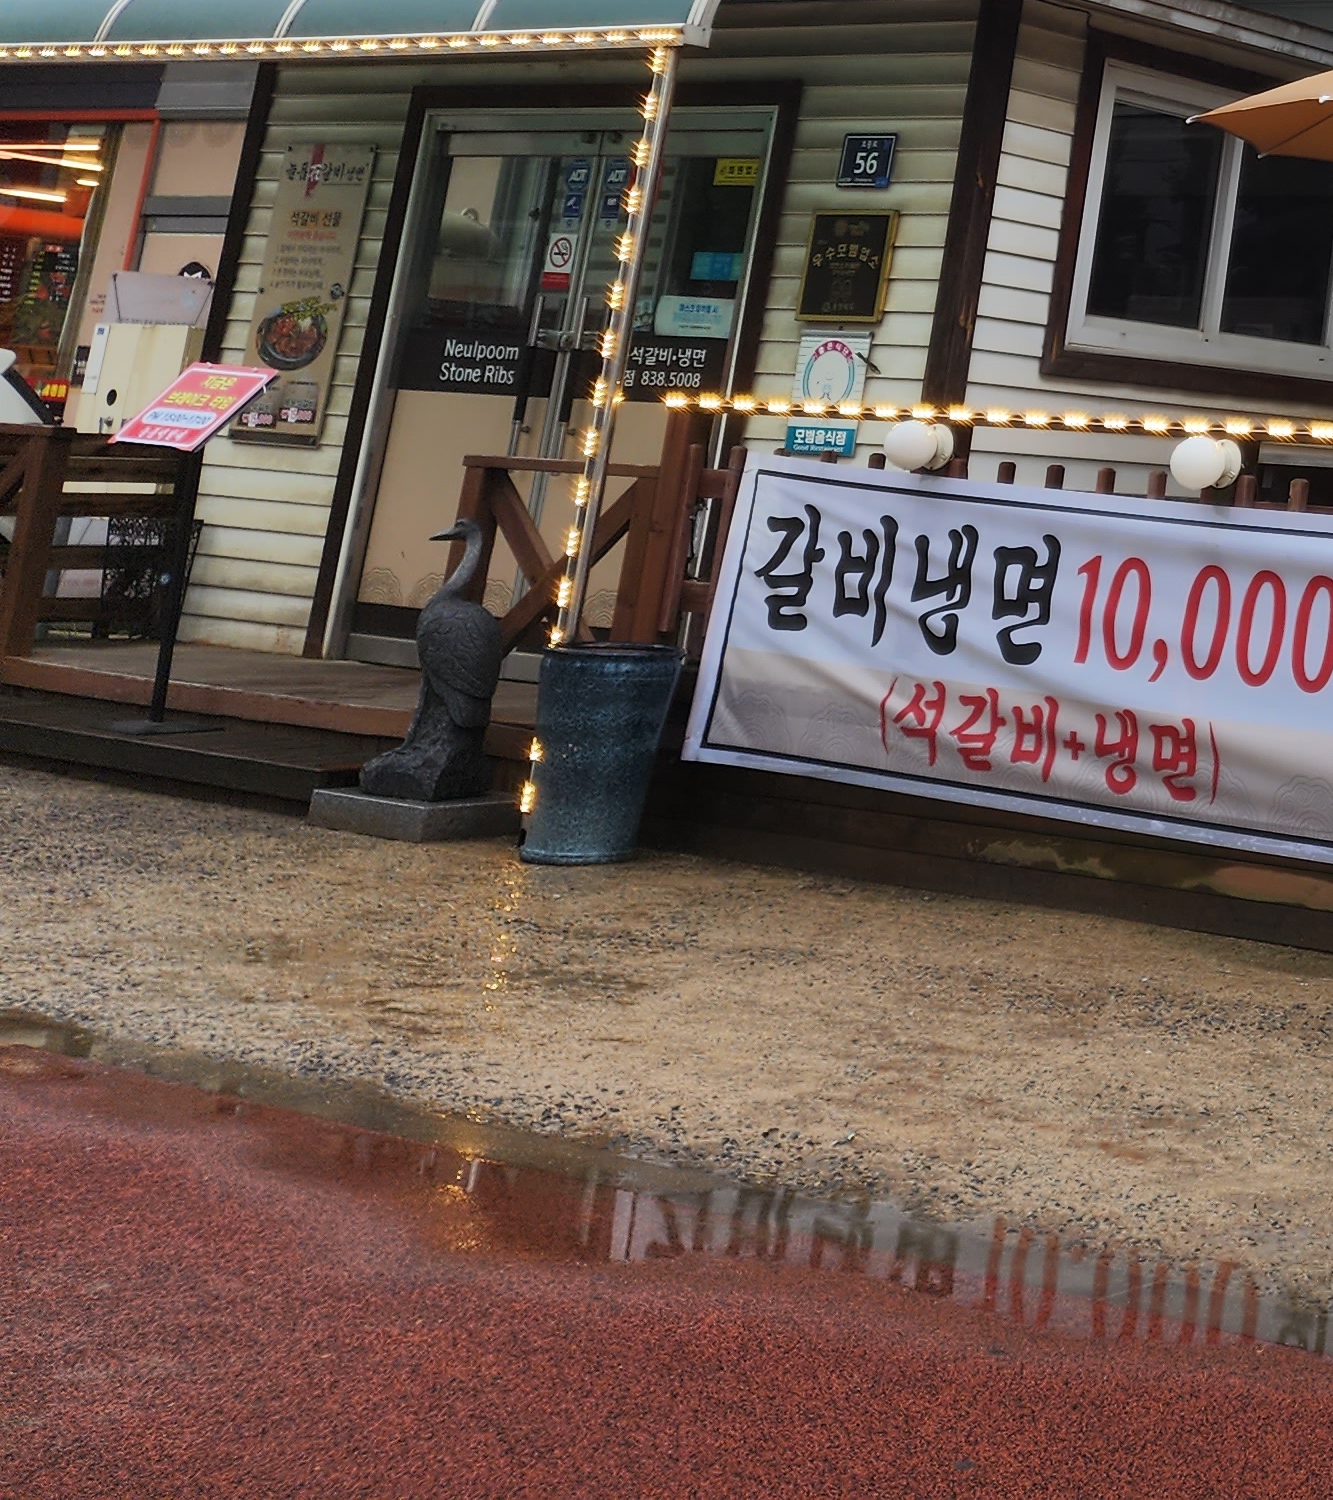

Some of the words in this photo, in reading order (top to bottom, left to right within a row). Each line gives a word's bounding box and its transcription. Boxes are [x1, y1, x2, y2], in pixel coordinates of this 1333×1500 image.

[853, 152, 879, 174] 56
[568, 169, 588, 182] ADT
[608, 169, 628, 182] ADT
[444, 340, 519, 361] Neulpoom
[439, 363, 481, 383] Stone
[484, 365, 515, 385] Ribs
[640, 371, 701, 388] 838.5008
[793, 429, 847, 447] 모범음식점
